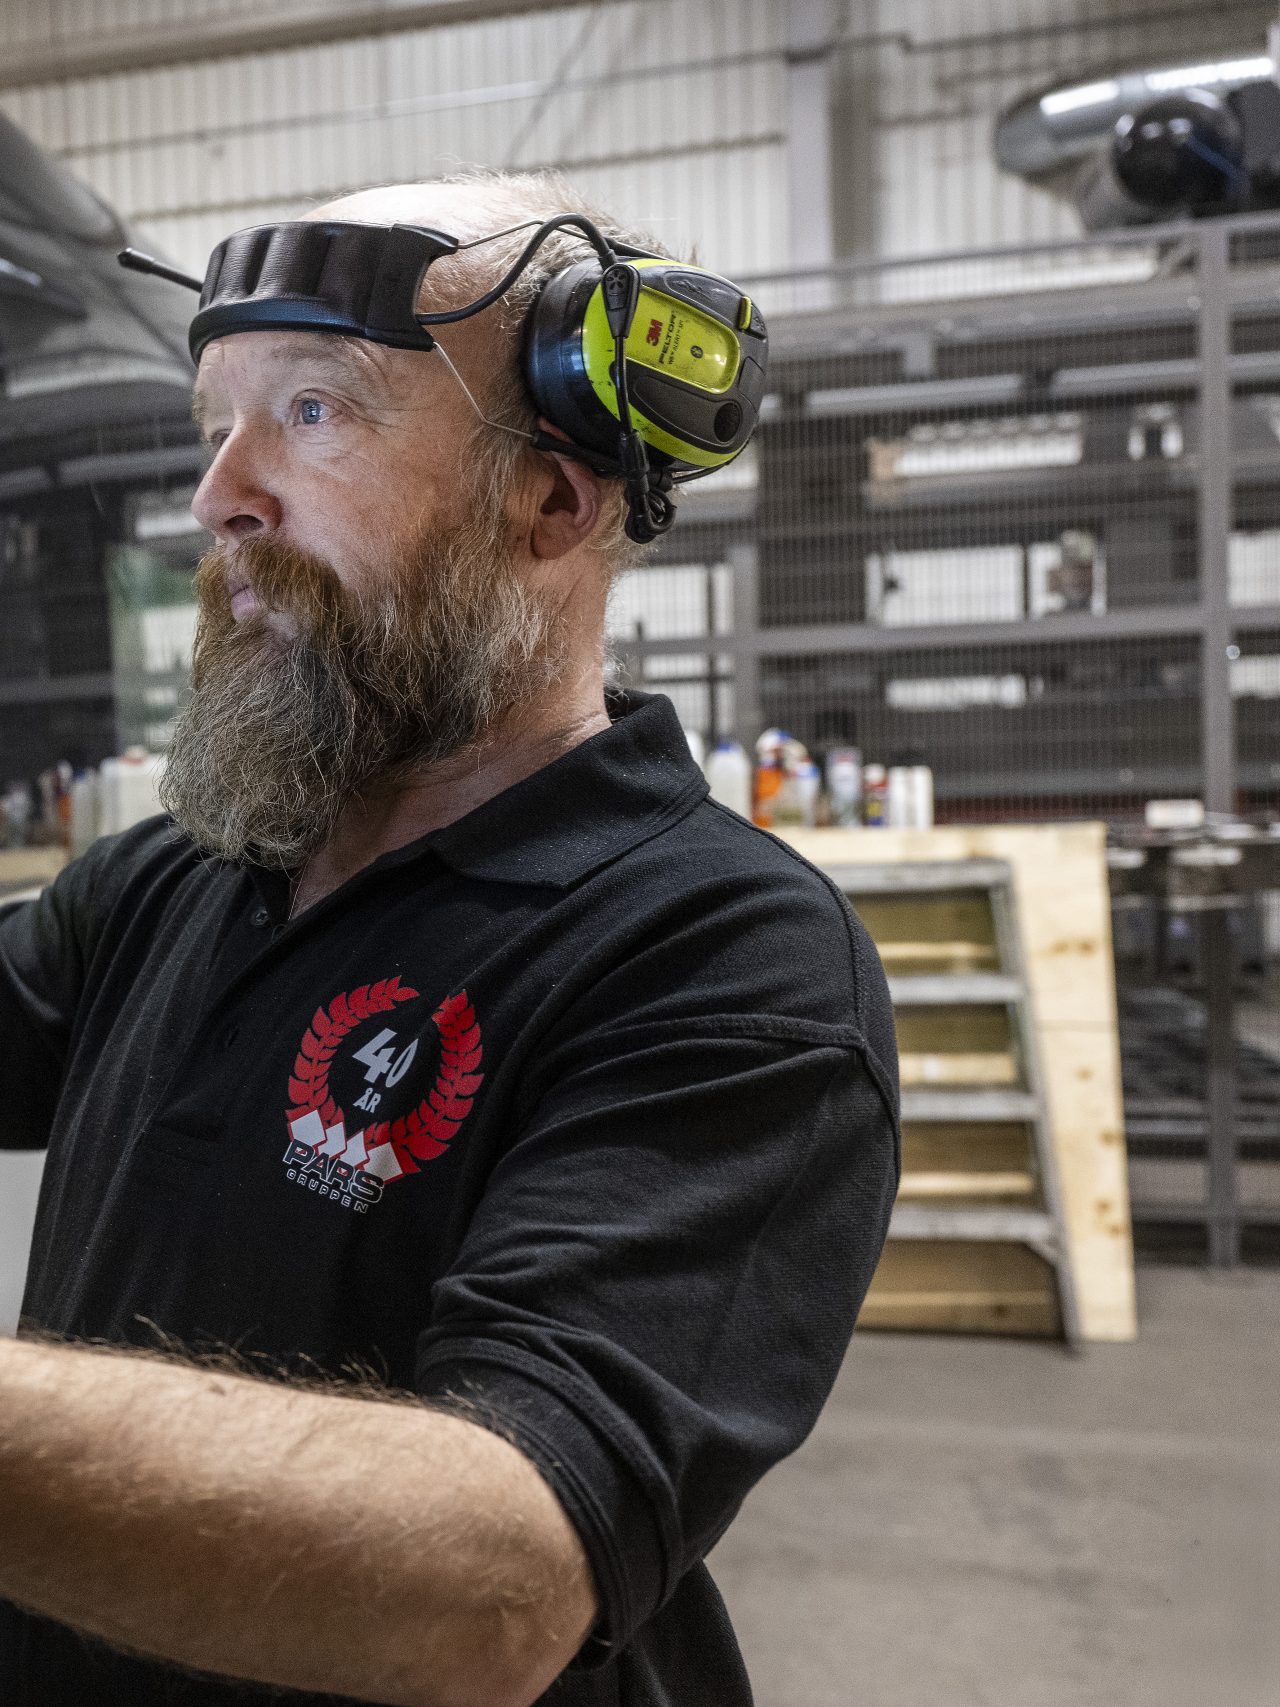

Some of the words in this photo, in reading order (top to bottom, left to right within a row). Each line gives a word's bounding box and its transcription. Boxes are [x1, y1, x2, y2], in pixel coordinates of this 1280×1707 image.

[646, 318, 663, 346] 3M
[351, 1027, 419, 1088] 40
[352, 1087, 382, 1113] ÅR
[282, 1138, 385, 1203] PARS
[286, 1168, 369, 1214] GRUPPEN
